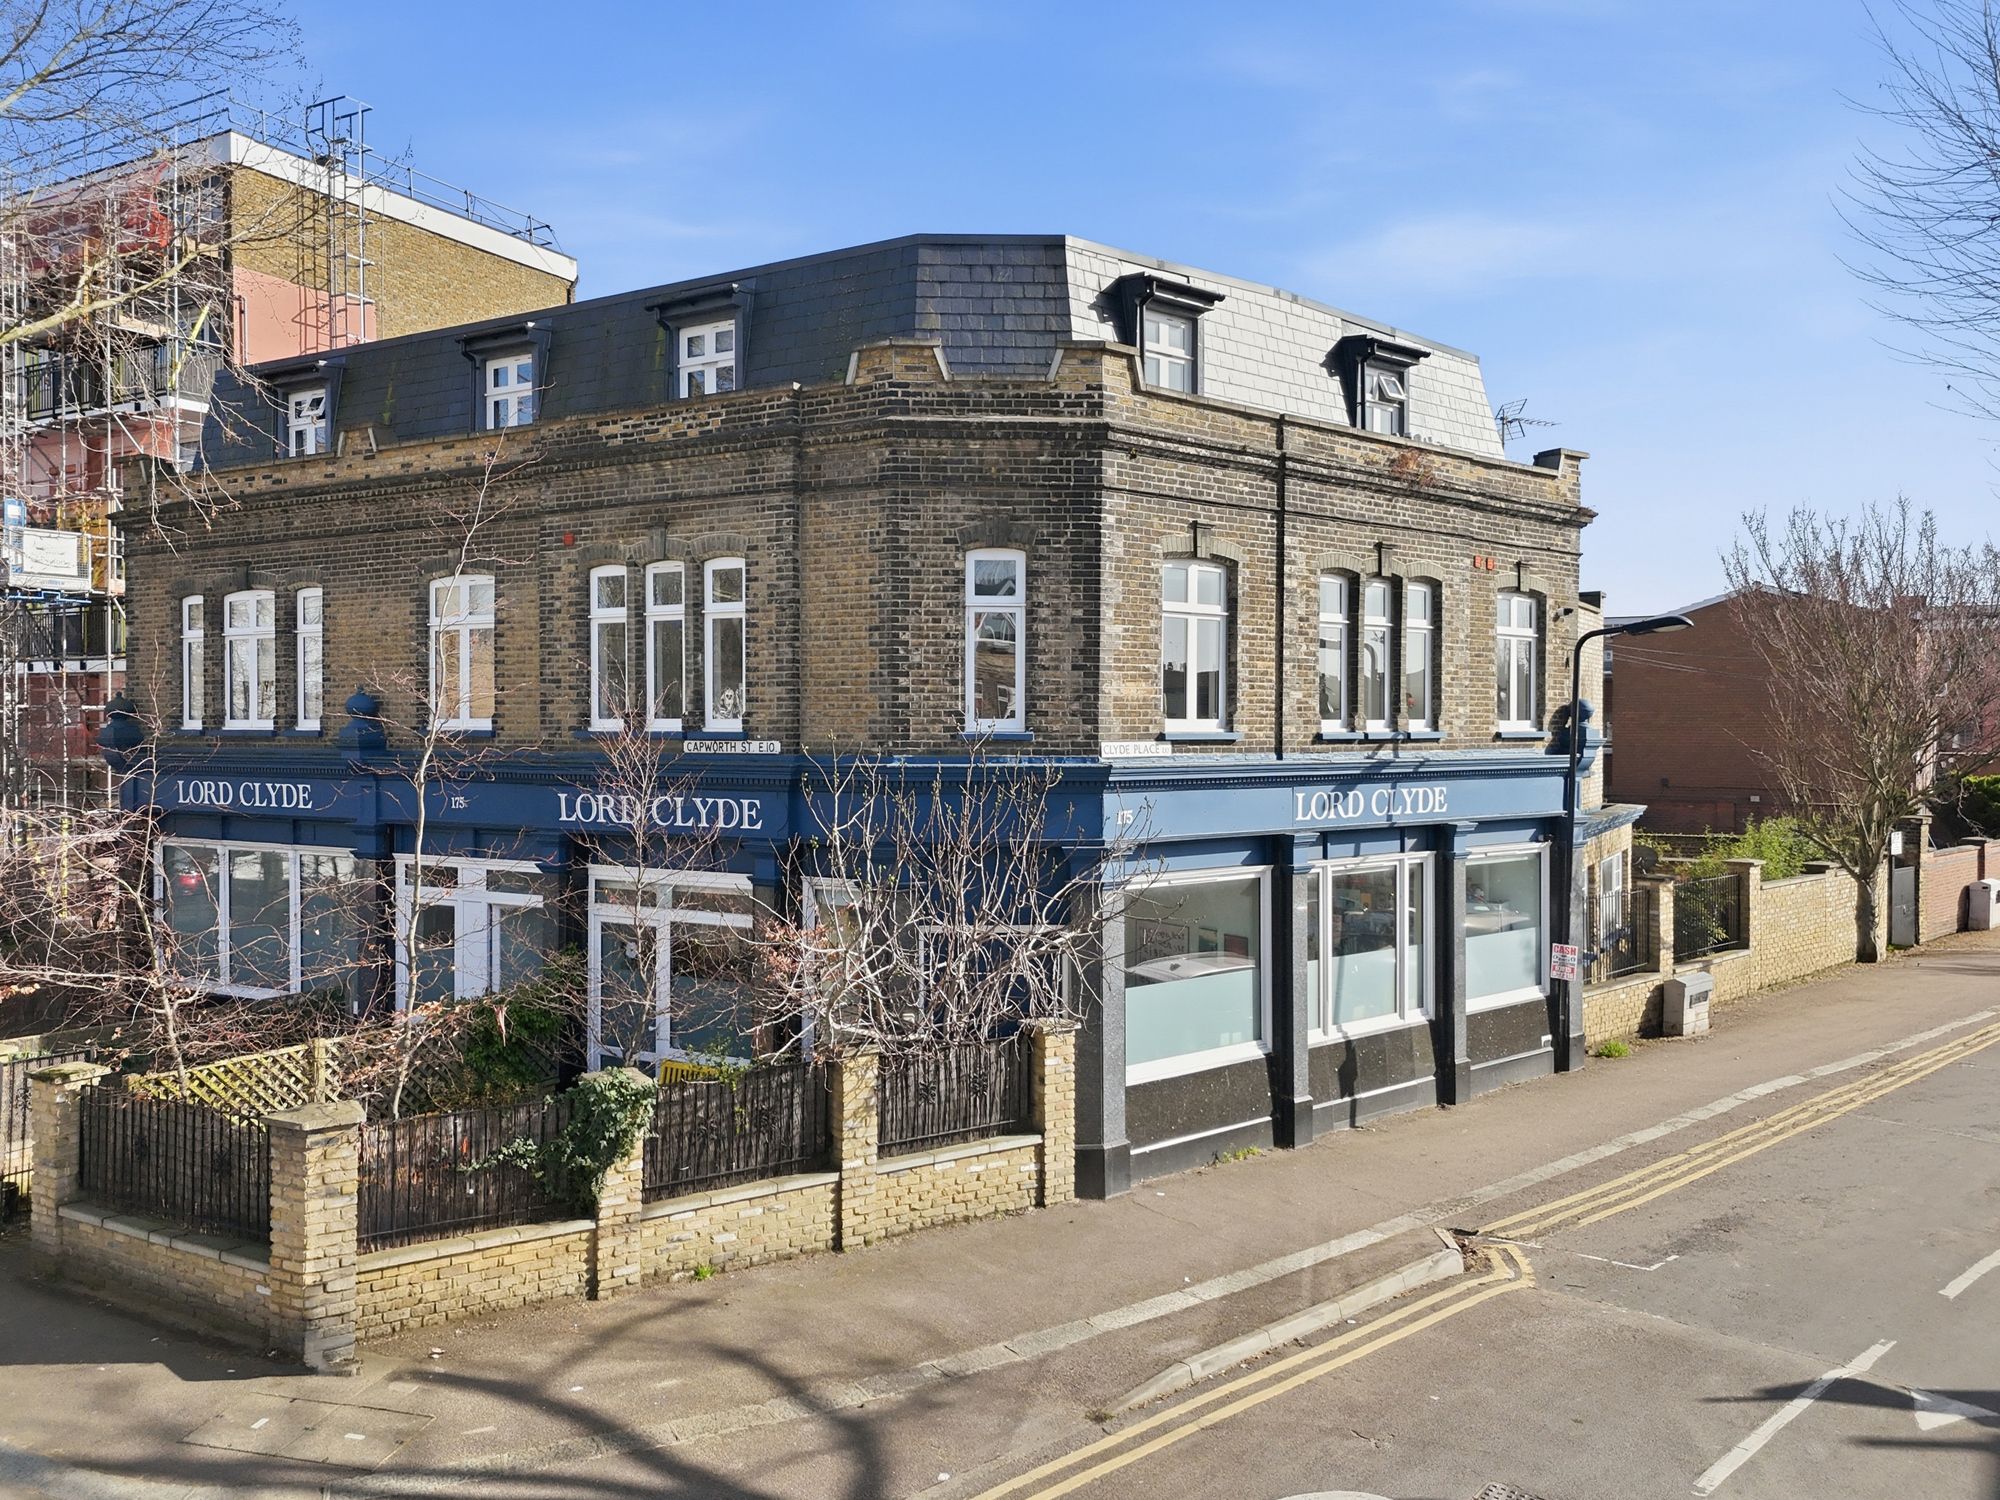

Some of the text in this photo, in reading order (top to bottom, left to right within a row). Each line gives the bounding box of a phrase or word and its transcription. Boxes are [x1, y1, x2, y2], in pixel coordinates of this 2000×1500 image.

[687, 741, 737, 753] CAPWORTH
[741, 741, 755, 753] ST.
[1103, 744, 1130, 755] CLYDE
[1134, 743, 1159, 754] PLACE
[177, 780, 312, 809] LORD CLYDE
[451, 796, 465, 809] 175
[1296, 787, 1448, 821] LORD CLYDE
[558, 793, 762, 830] LORD CLYDE
[1117, 810, 1133, 824] 175
[1553, 944, 1577, 956] CASH
